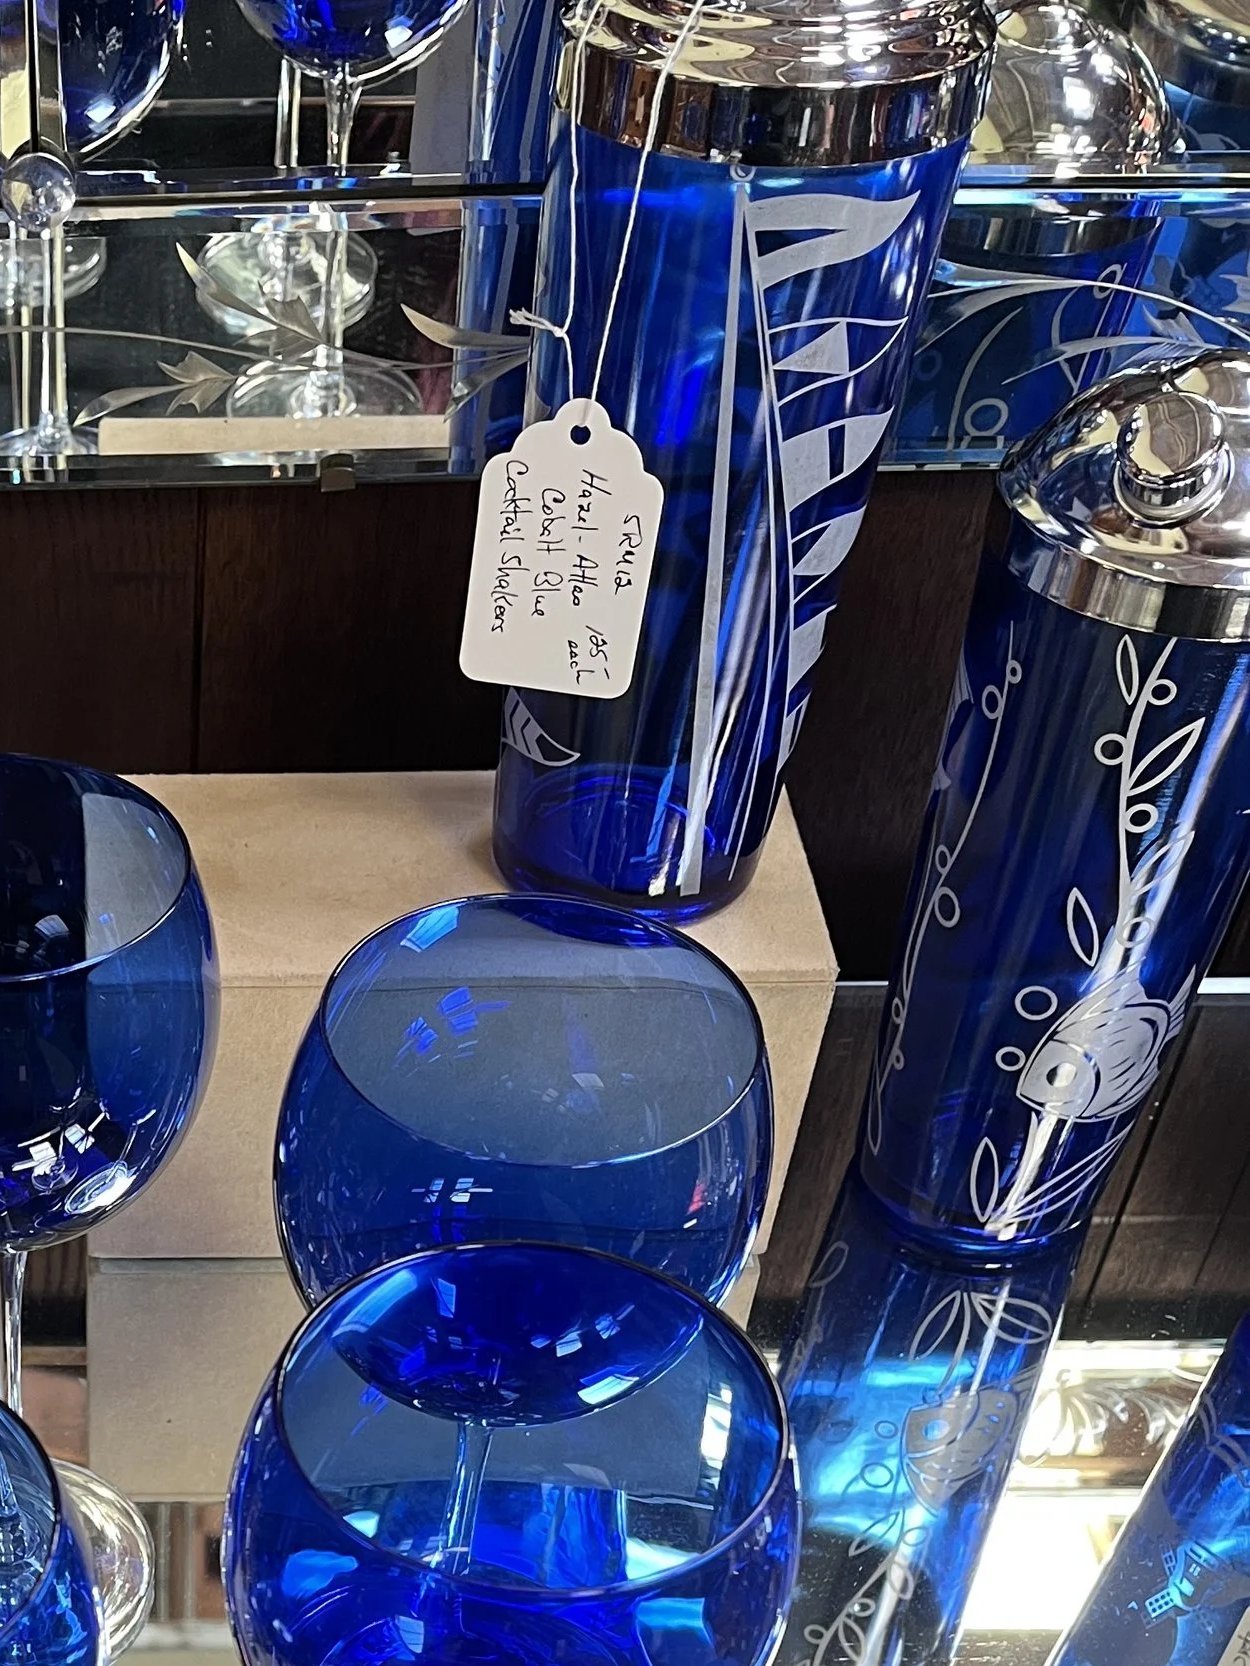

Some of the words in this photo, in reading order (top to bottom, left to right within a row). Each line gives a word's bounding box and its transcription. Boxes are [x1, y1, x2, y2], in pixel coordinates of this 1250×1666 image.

[499, 460, 533, 544] Cocktail
[536, 488, 567, 555] Cobalt
[490, 551, 531, 633] Shakers
[531, 571, 563, 617] Blue
[567, 640, 595, 685] each
